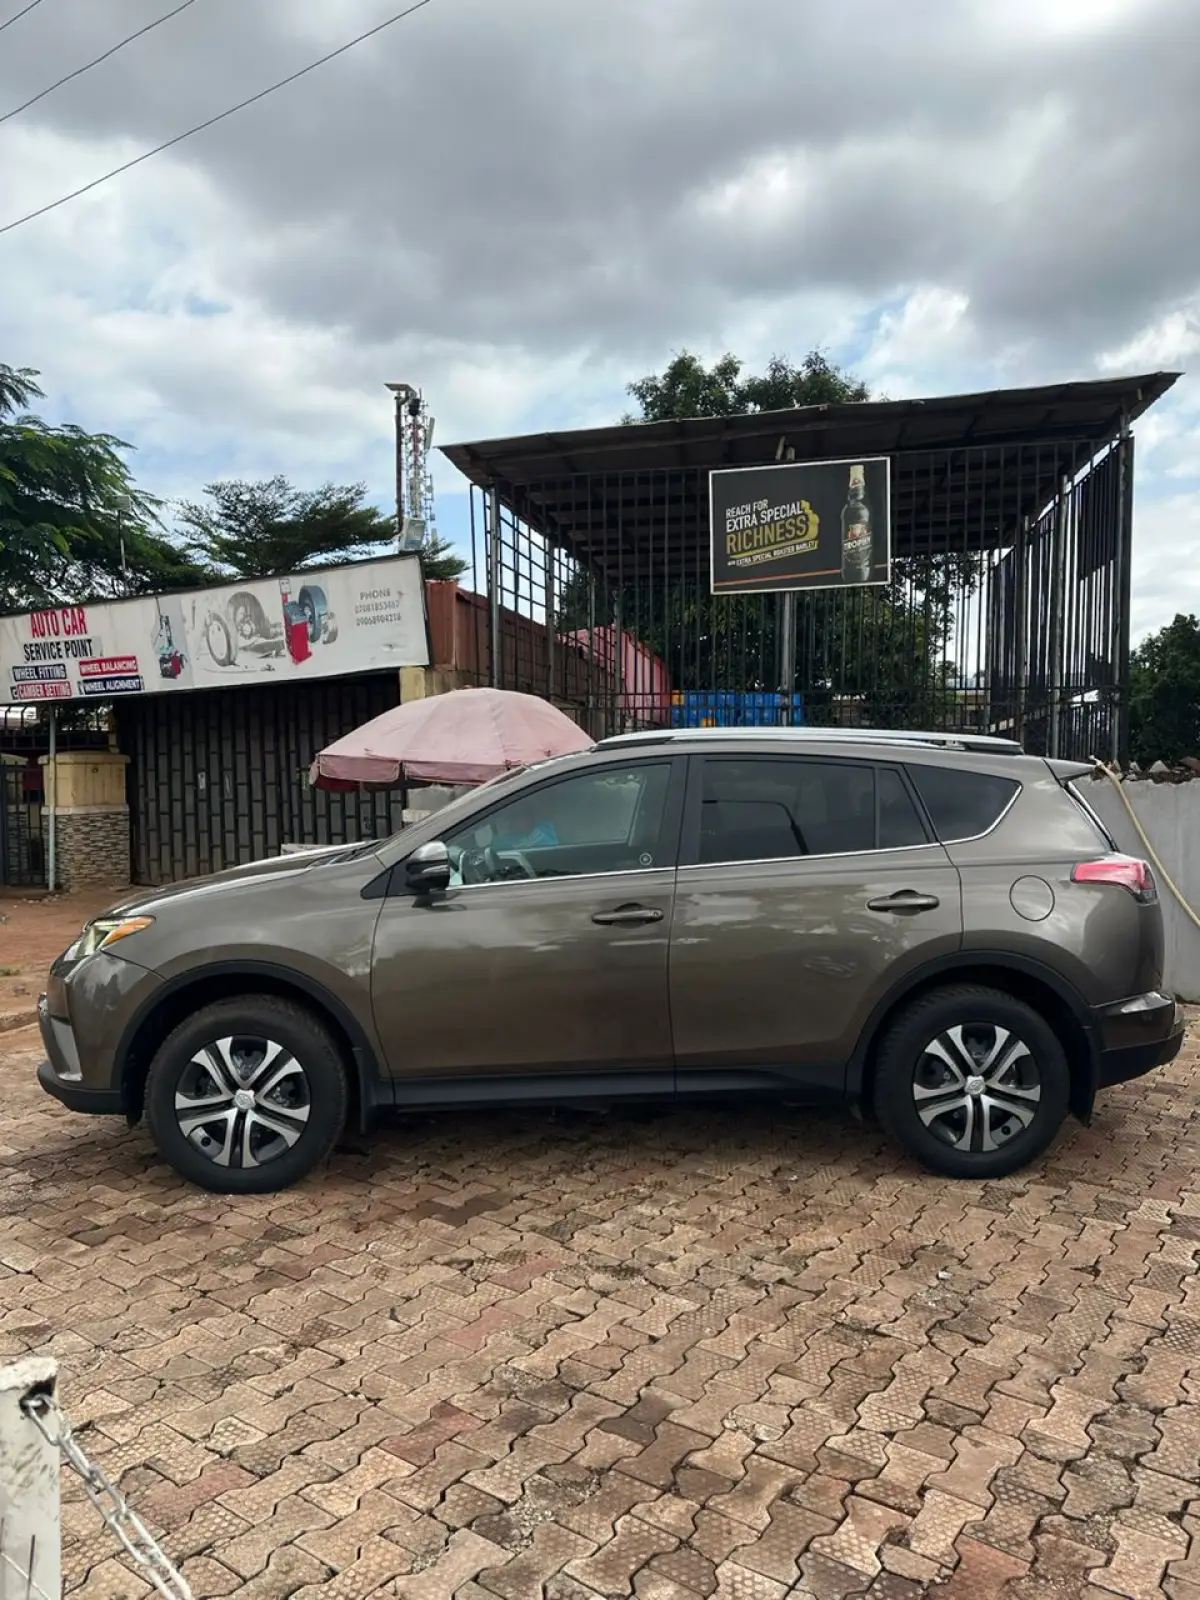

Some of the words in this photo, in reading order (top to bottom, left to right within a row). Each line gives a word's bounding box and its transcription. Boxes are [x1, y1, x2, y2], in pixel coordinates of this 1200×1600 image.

[726, 504, 751, 519] REACH
[753, 498, 768, 511] FOR
[726, 513, 757, 532] EXTRA
[760, 501, 804, 523] SPECIAL
[726, 514, 806, 554] RICHNESS
[736, 557, 751, 566] EXTRA
[752, 552, 771, 563] SPECIAL
[360, 588, 391, 600] PHONE
[31, 609, 60, 638] AUTO
[61, 607, 88, 636] CAR
[24, 641, 62, 661] SERVICE
[65, 639, 93, 658] POINT
[14, 666, 37, 681] WHEEL
[38, 664, 66, 680] FITTING
[80, 662, 101, 673] WHEEL
[101, 659, 137, 672] BALANCING
[19, 683, 44, 698] CAMBER
[45, 682, 71, 697] SETTING
[84, 681, 105, 692] WHEEL
[105, 679, 140, 691] ALIGNMENT
